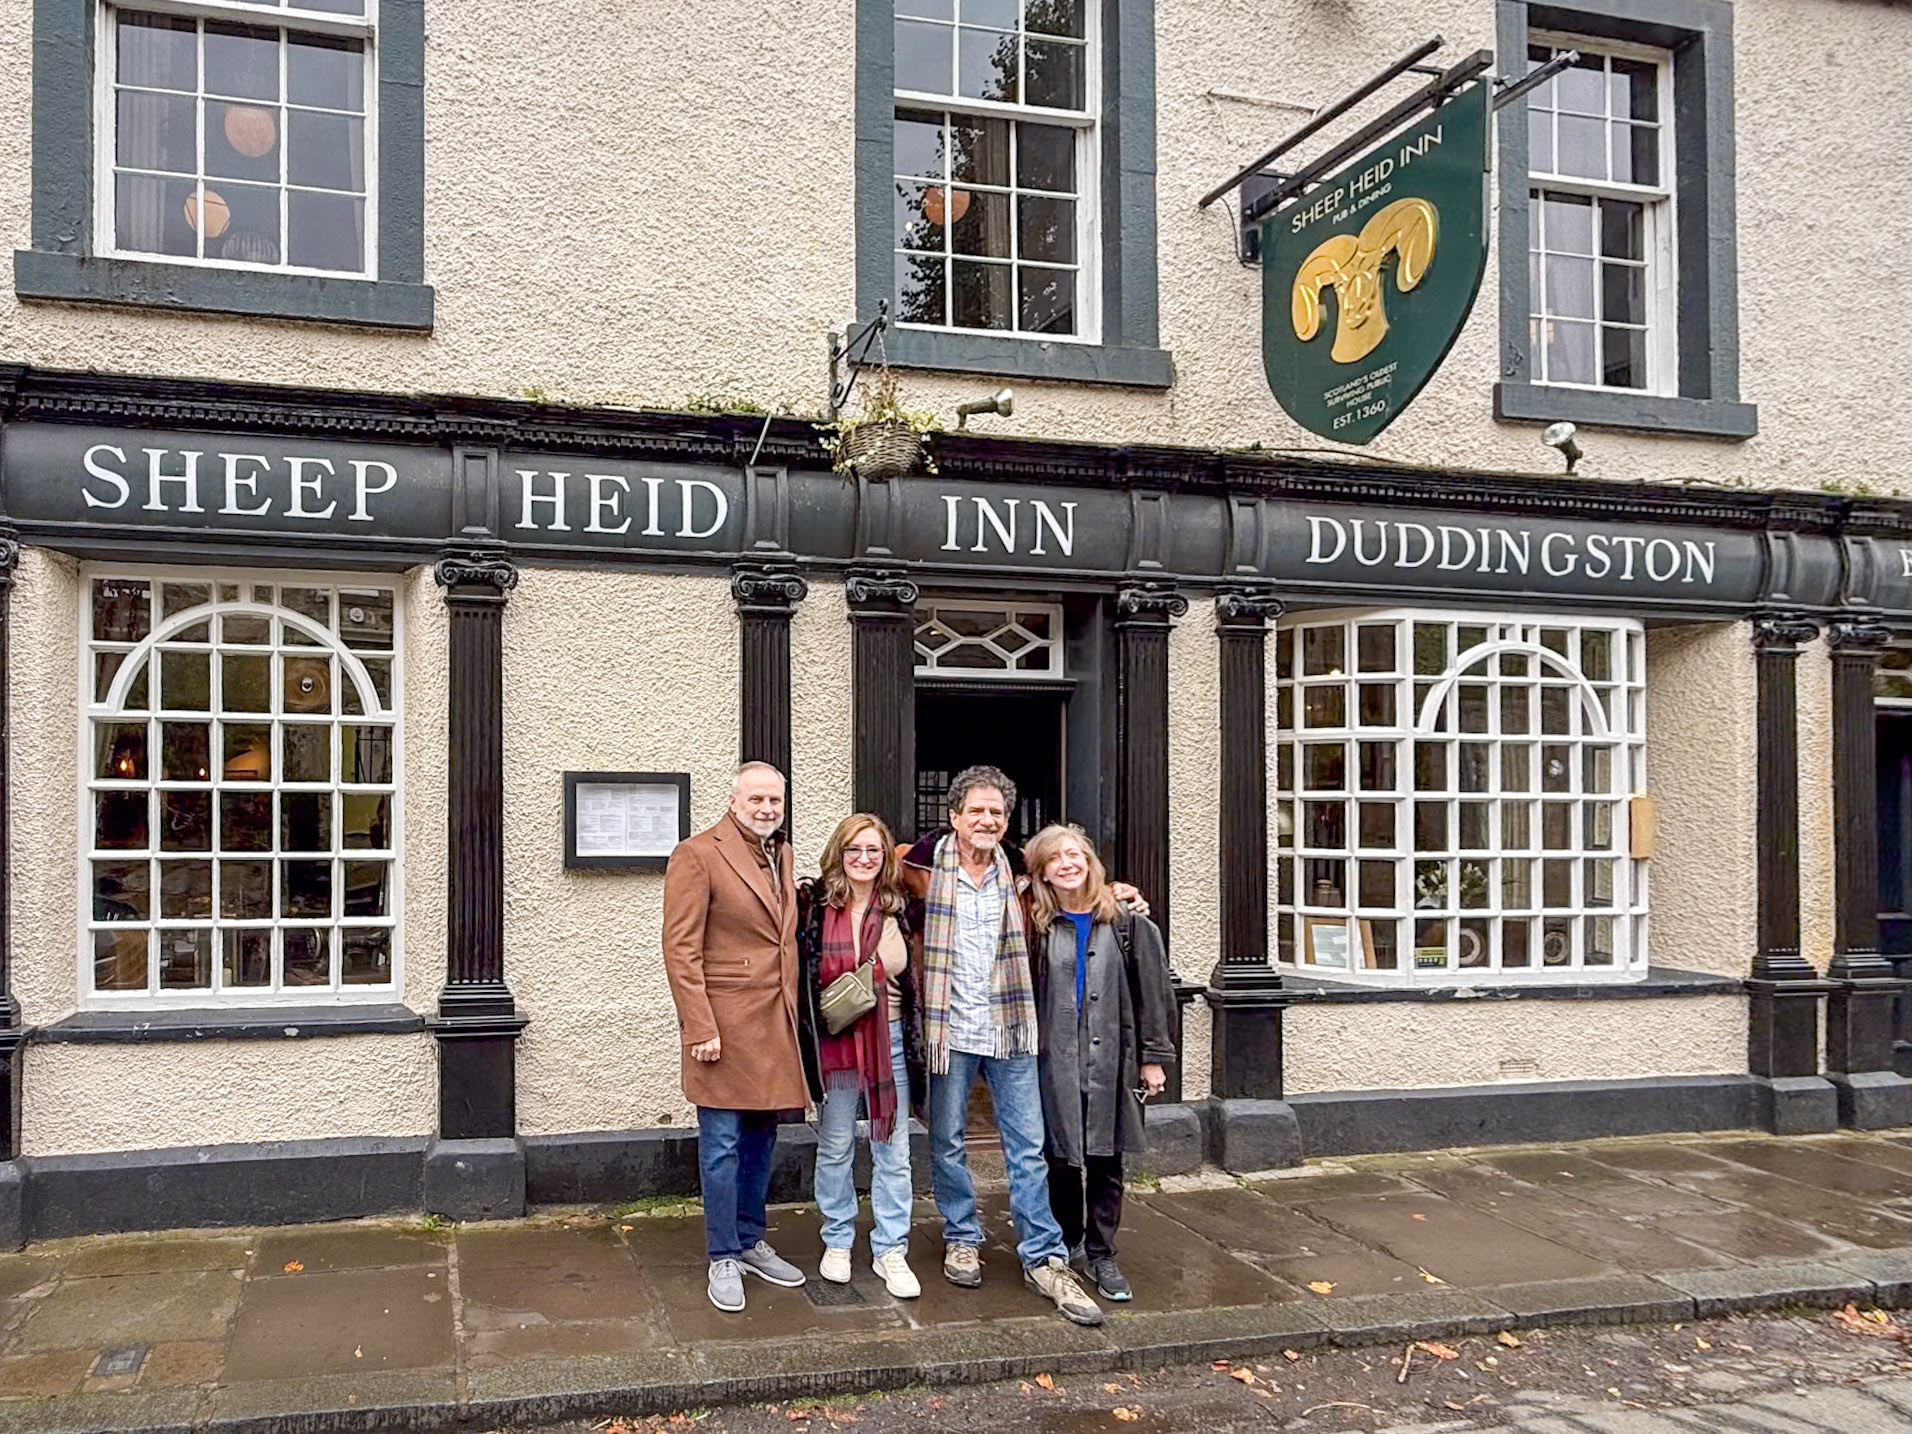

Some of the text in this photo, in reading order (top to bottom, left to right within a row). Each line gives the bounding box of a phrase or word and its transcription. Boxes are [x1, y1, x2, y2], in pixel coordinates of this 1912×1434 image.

[1291, 124, 1443, 234] SHEEP HEID INN
[1332, 182, 1392, 225] PUB & DINING
[1369, 361, 1398, 380] OLDEST
[81, 444, 398, 521] SHEEP
[514, 469, 728, 538] HEID
[940, 495, 1078, 556] INN
[1304, 515, 1717, 584] DUDDINGSTON
